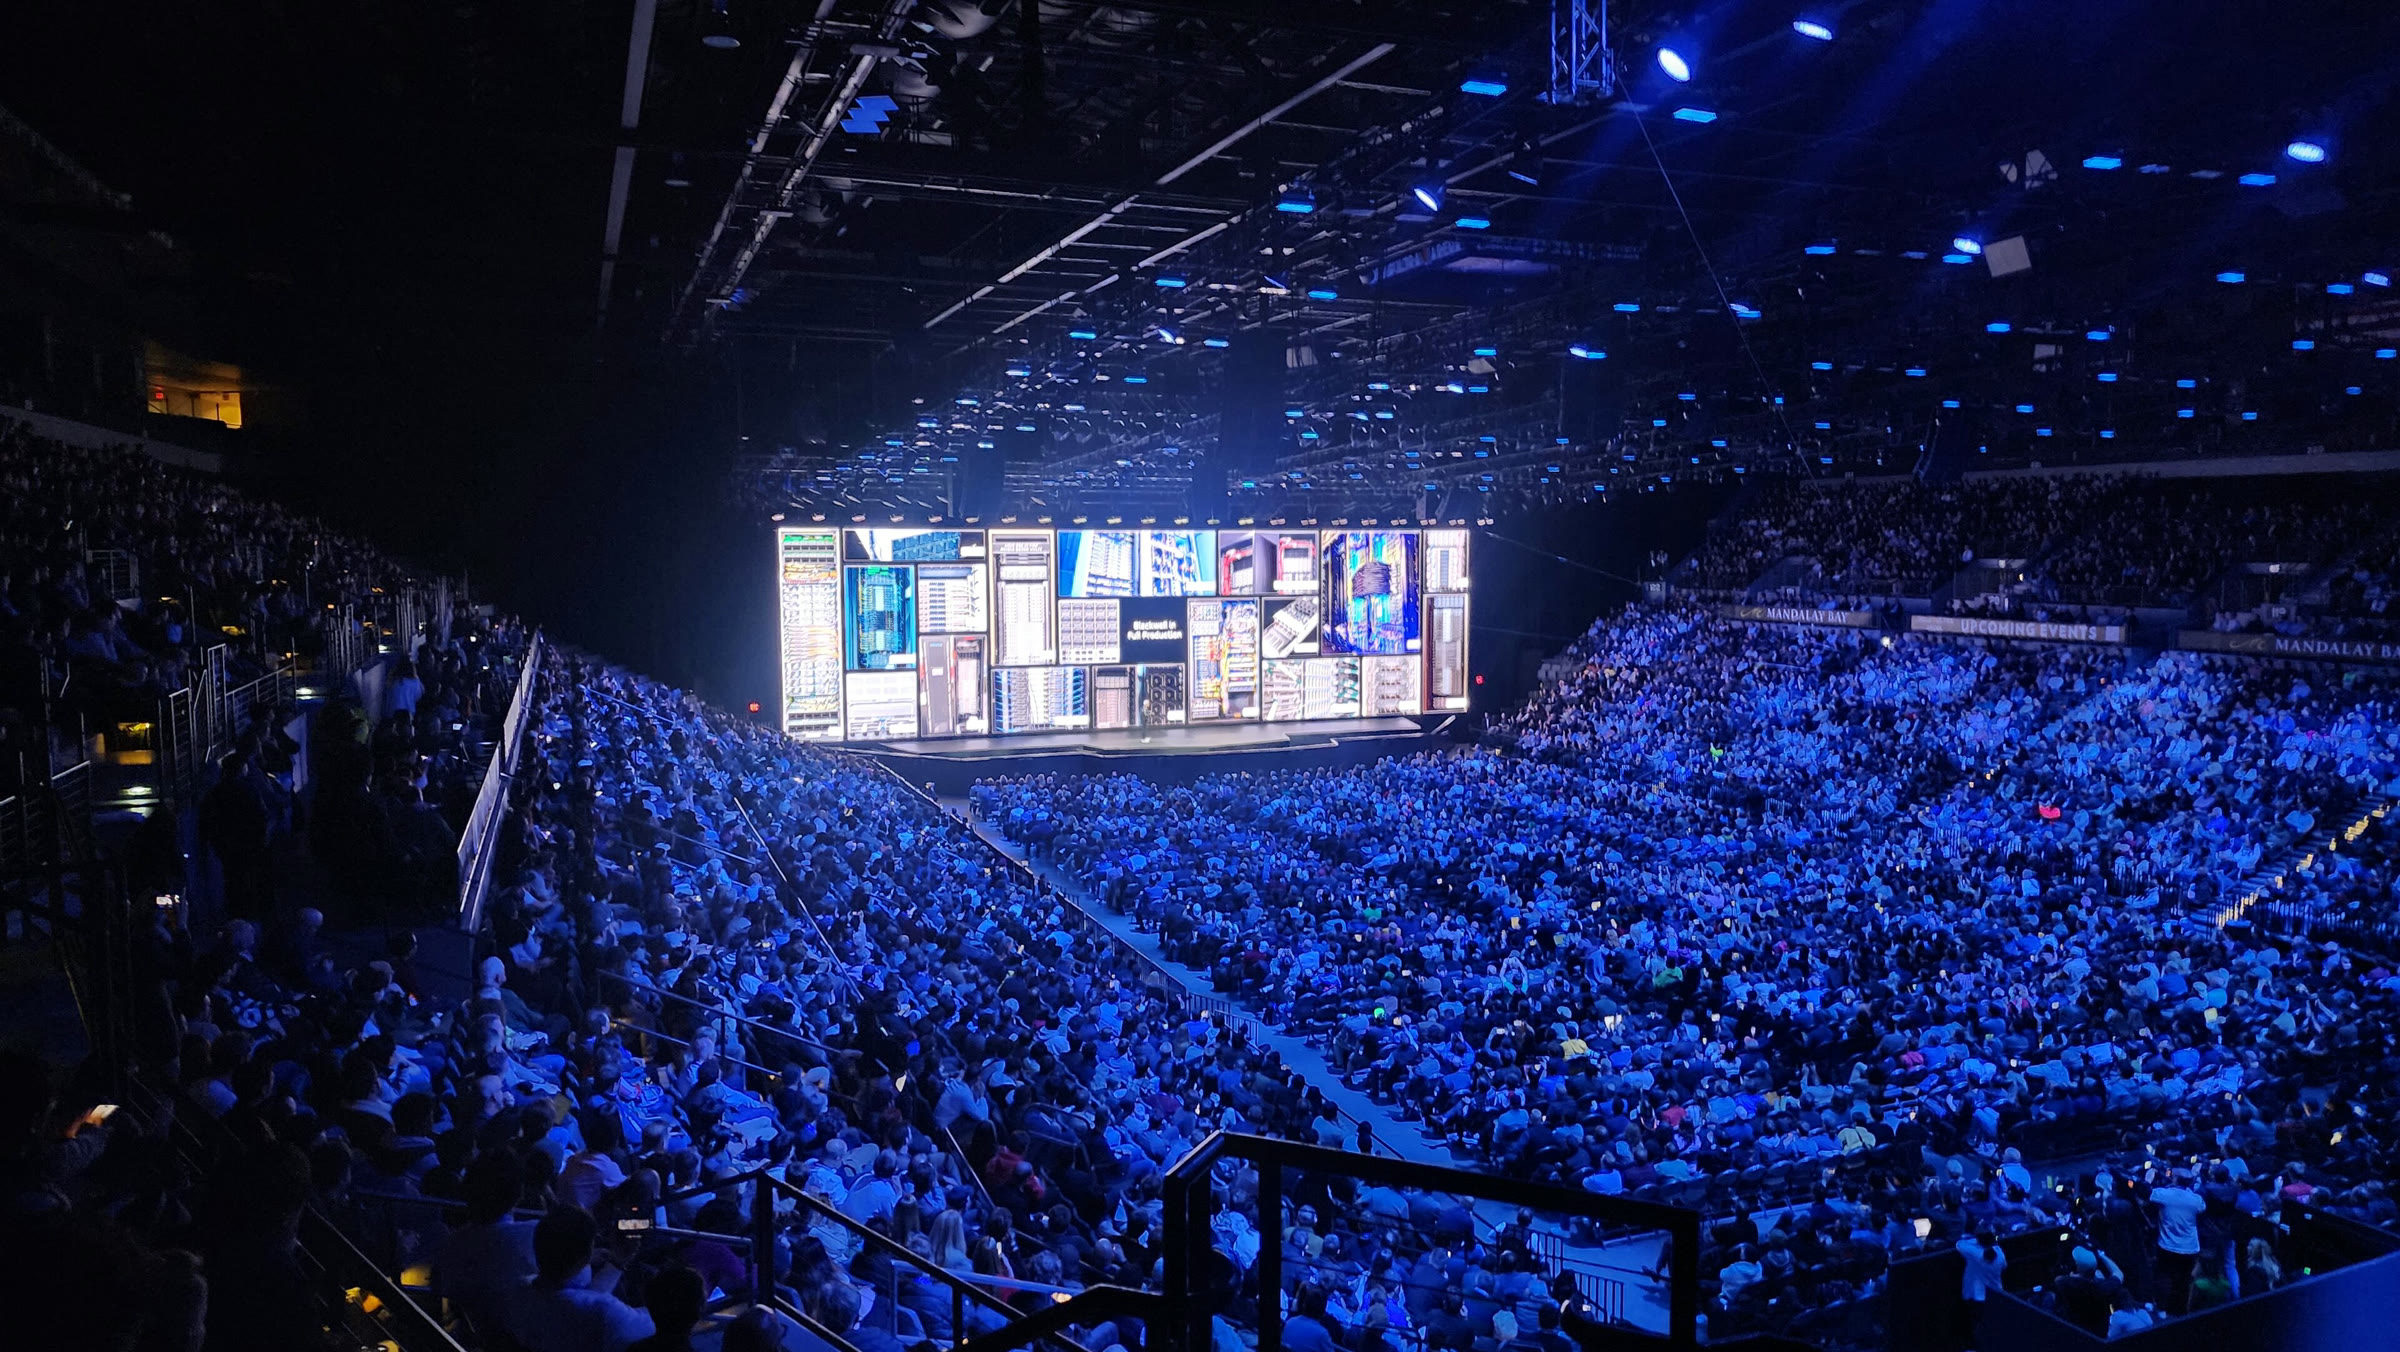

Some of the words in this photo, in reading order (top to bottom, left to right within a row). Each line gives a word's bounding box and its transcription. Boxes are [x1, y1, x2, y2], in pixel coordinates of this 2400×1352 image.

[1767, 608, 1825, 622] MANDALAY
[1828, 611, 1849, 623] BAY
[1133, 620, 1168, 630] Blackwell
[1960, 619, 2035, 637] UPCOMING
[2040, 623, 2097, 640] EVENTS
[1127, 630, 1141, 640] Full
[1142, 630, 1183, 640] Production
[2275, 639, 2374, 656] MANDALAY
